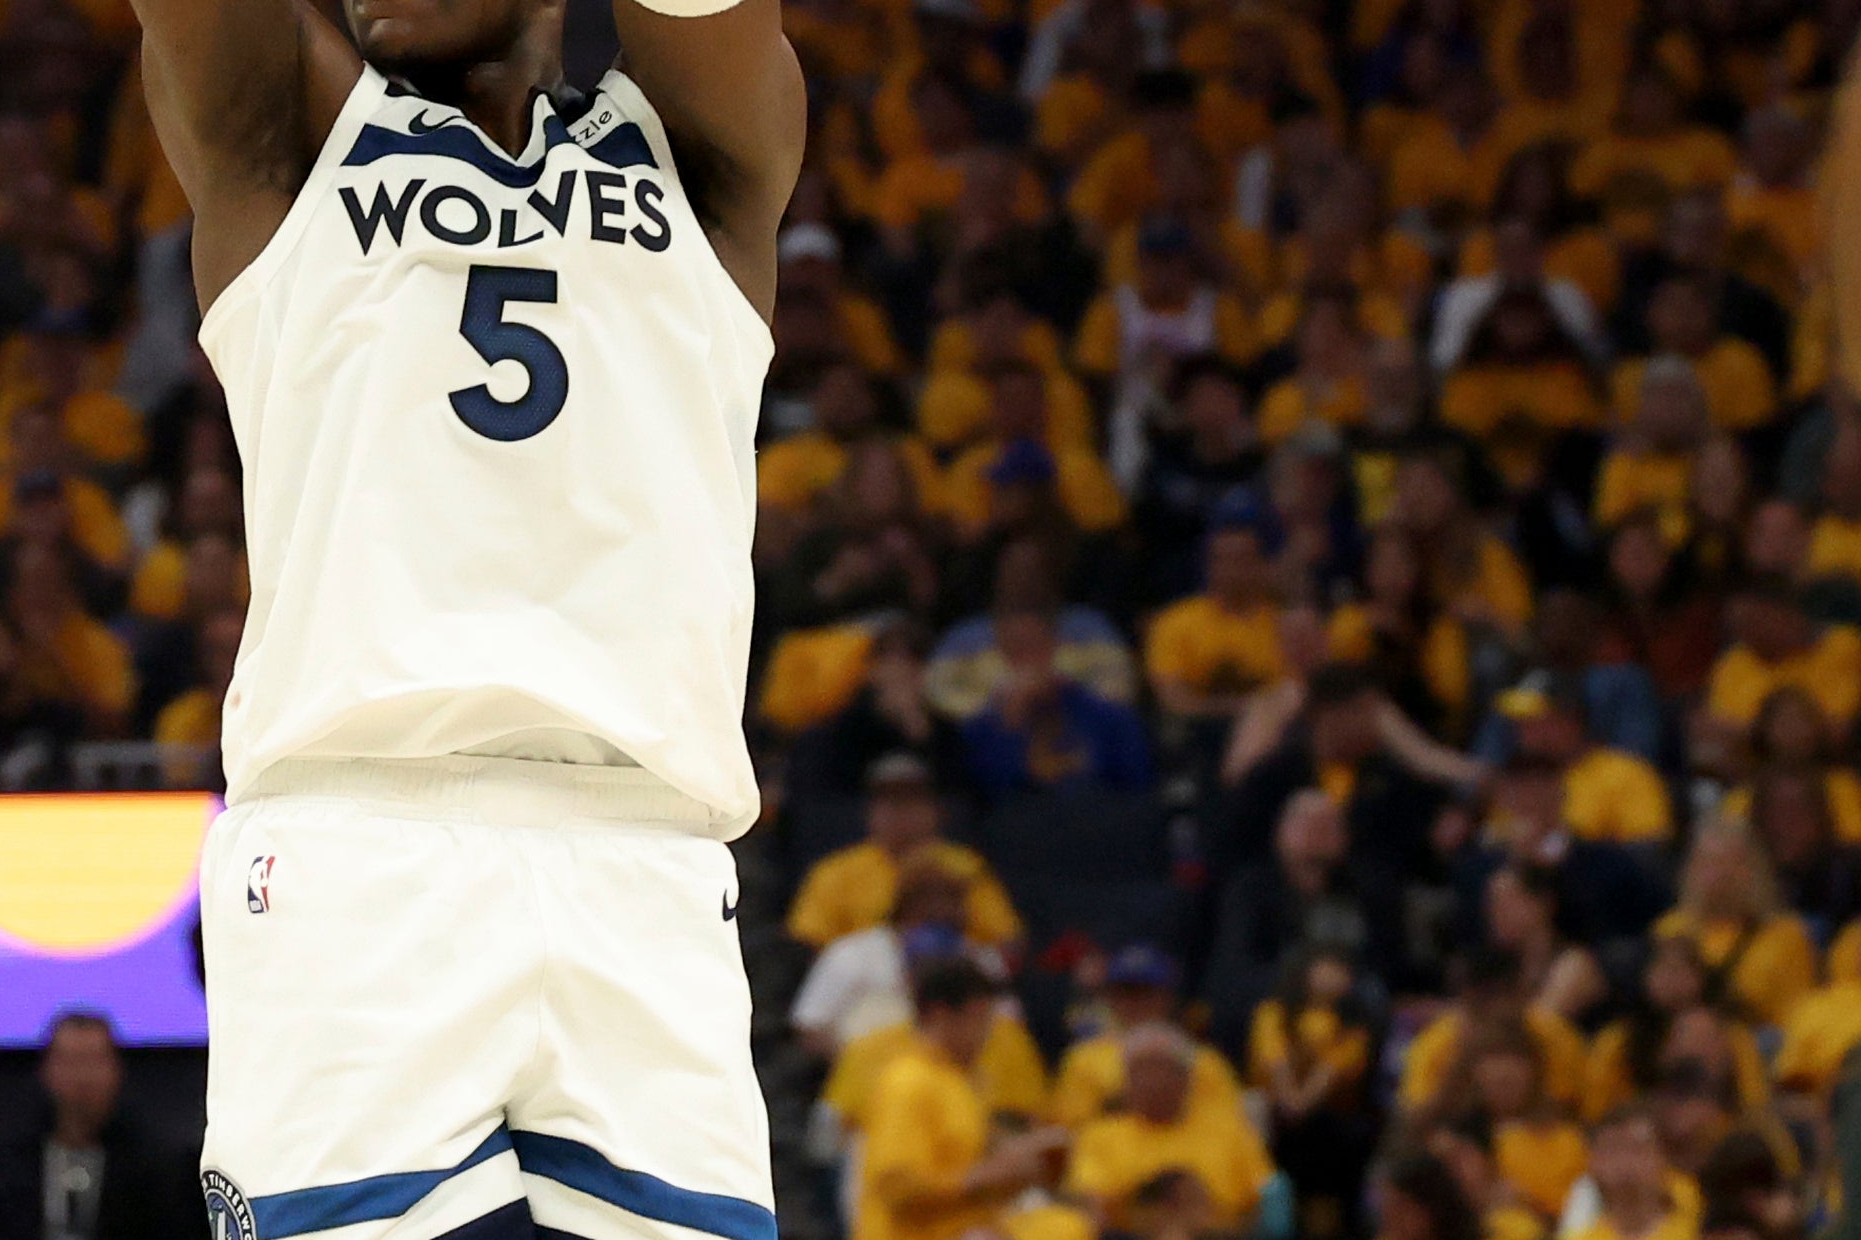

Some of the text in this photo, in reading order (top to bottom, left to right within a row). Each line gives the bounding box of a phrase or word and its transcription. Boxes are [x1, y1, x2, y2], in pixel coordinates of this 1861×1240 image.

[575, 110, 613, 144] zle
[337, 169, 672, 257] WOLVES
[447, 263, 570, 442] 5
